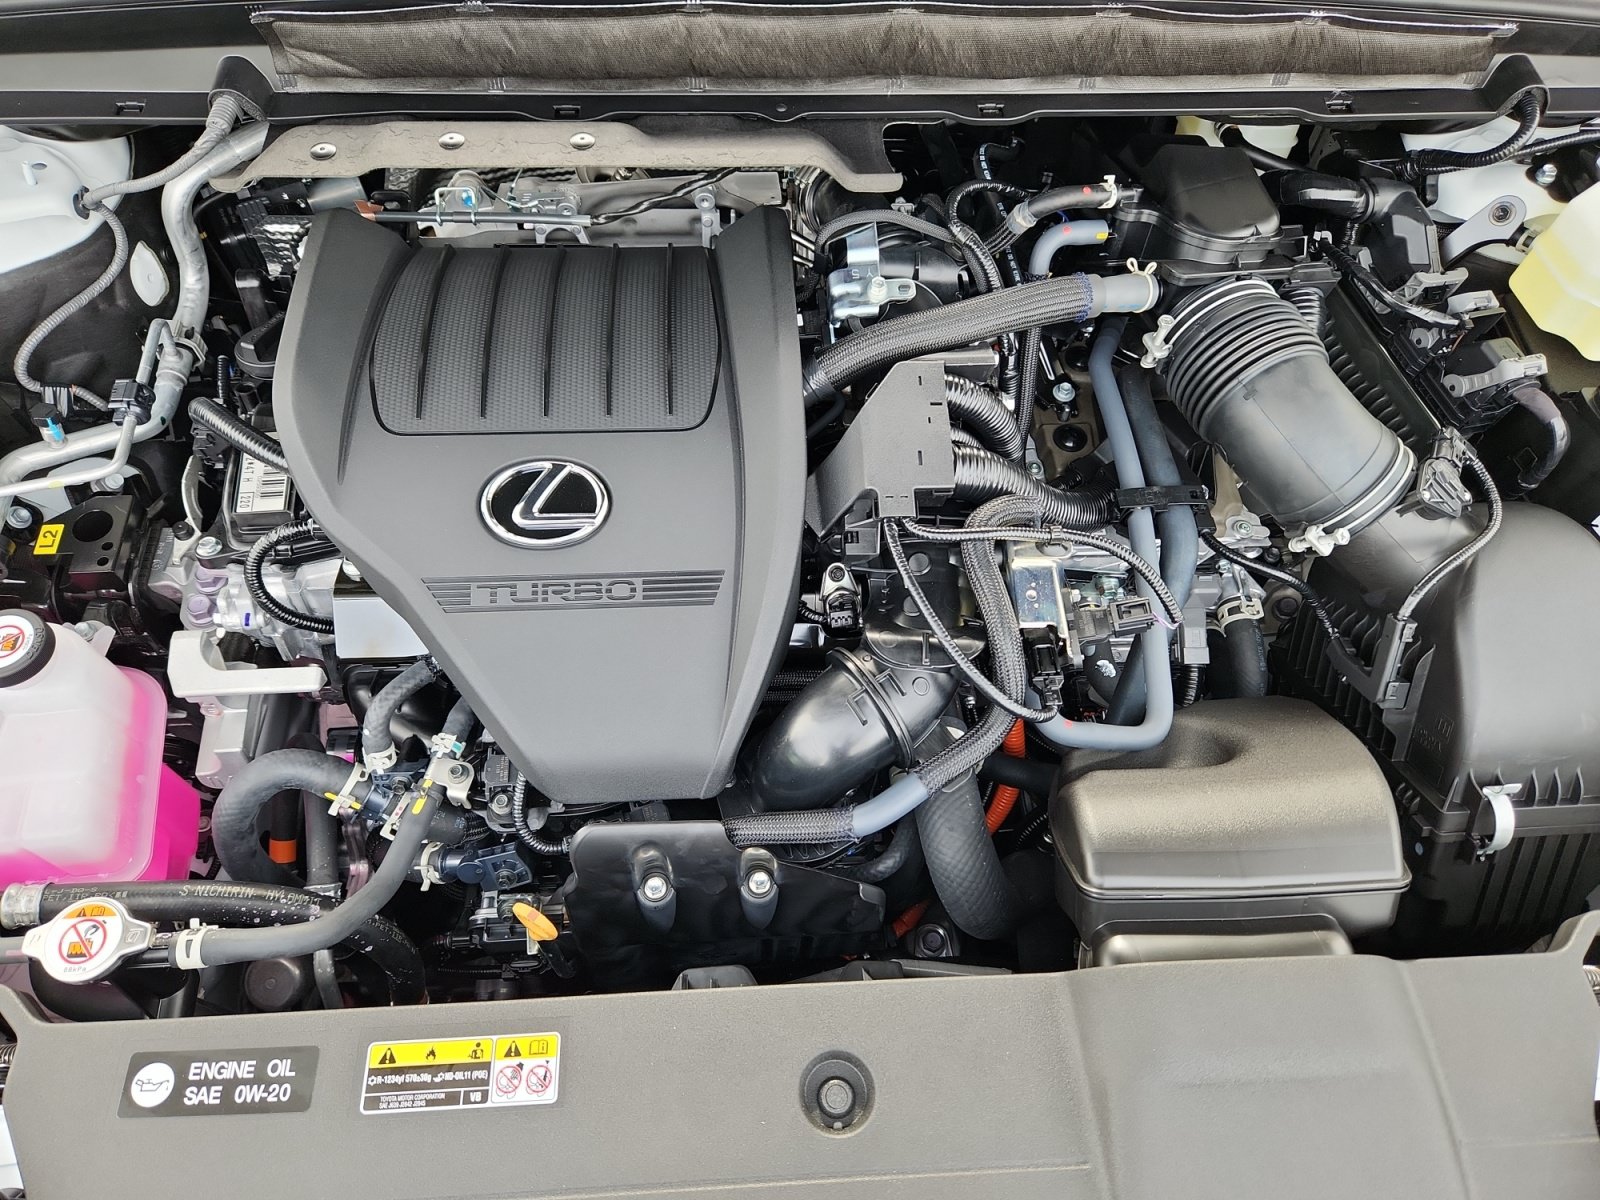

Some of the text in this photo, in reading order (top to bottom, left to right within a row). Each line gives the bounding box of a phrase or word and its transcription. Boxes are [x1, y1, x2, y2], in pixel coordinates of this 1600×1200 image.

[239, 495, 251, 508] 220
[38, 530, 59, 548] L2
[476, 578, 638, 605] TURBO
[26, 627, 46, 660] DENSO
[188, 1058, 296, 1081] ENGINE OIL
[376, 1073, 405, 1085] R-1234yf
[472, 1070, 488, 1080] (POE)
[183, 1083, 292, 1105] SAE 0W-20
[414, 1092, 446, 1100] CORPORATION
[379, 1101, 388, 1109] SAE
